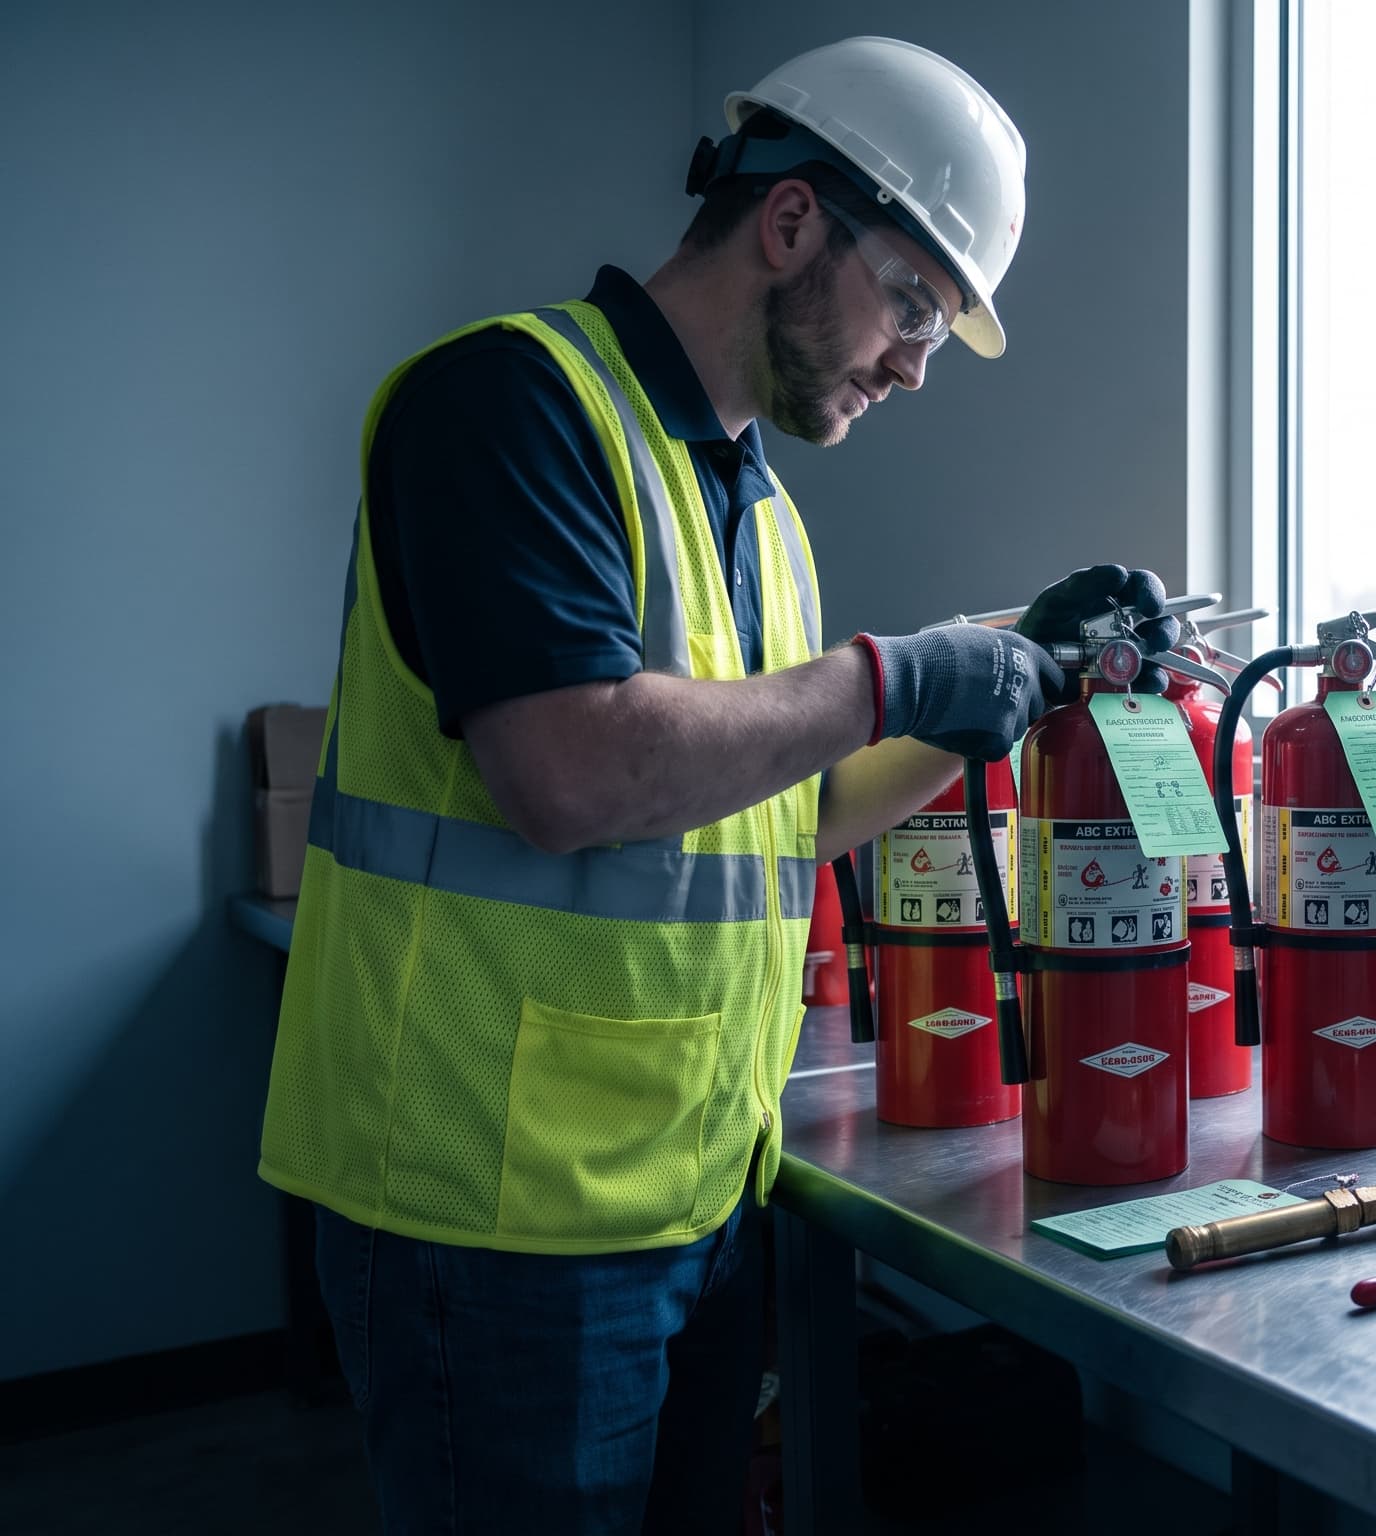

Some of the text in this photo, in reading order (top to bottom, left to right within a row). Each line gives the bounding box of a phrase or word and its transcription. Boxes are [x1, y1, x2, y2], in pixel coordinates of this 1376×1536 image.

[908, 818, 929, 828] ABC
[1313, 814, 1337, 825] ABC
[1075, 826, 1101, 837] ABC
